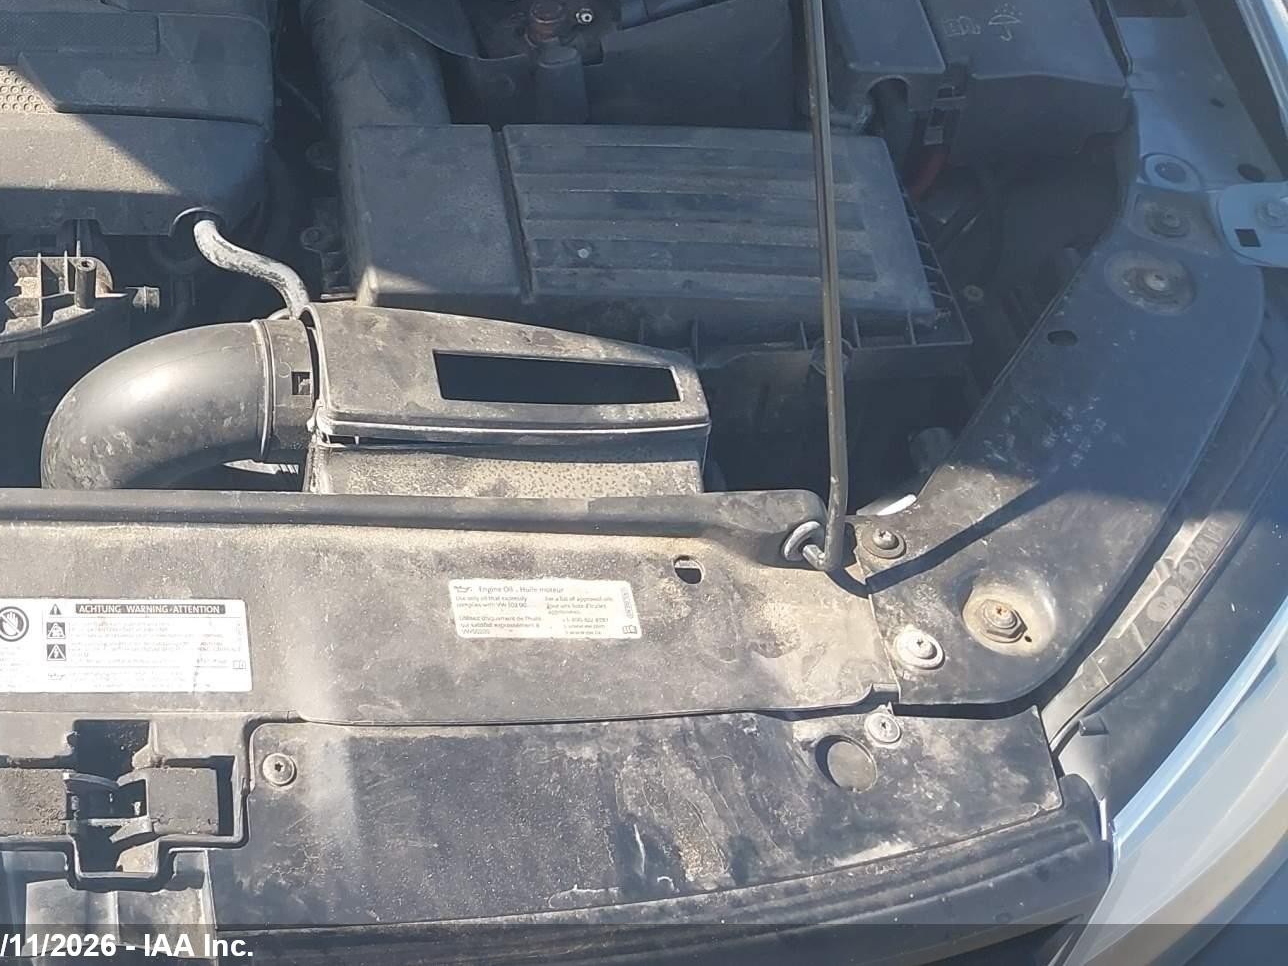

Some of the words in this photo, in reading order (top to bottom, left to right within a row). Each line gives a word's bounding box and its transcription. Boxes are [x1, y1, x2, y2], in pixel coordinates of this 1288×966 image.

[478, 586, 502, 594] Engine
[78, 604, 122, 614] ACHTUNG
[125, 604, 169, 614] WARNING
[173, 604, 220, 614] ATTENTION
